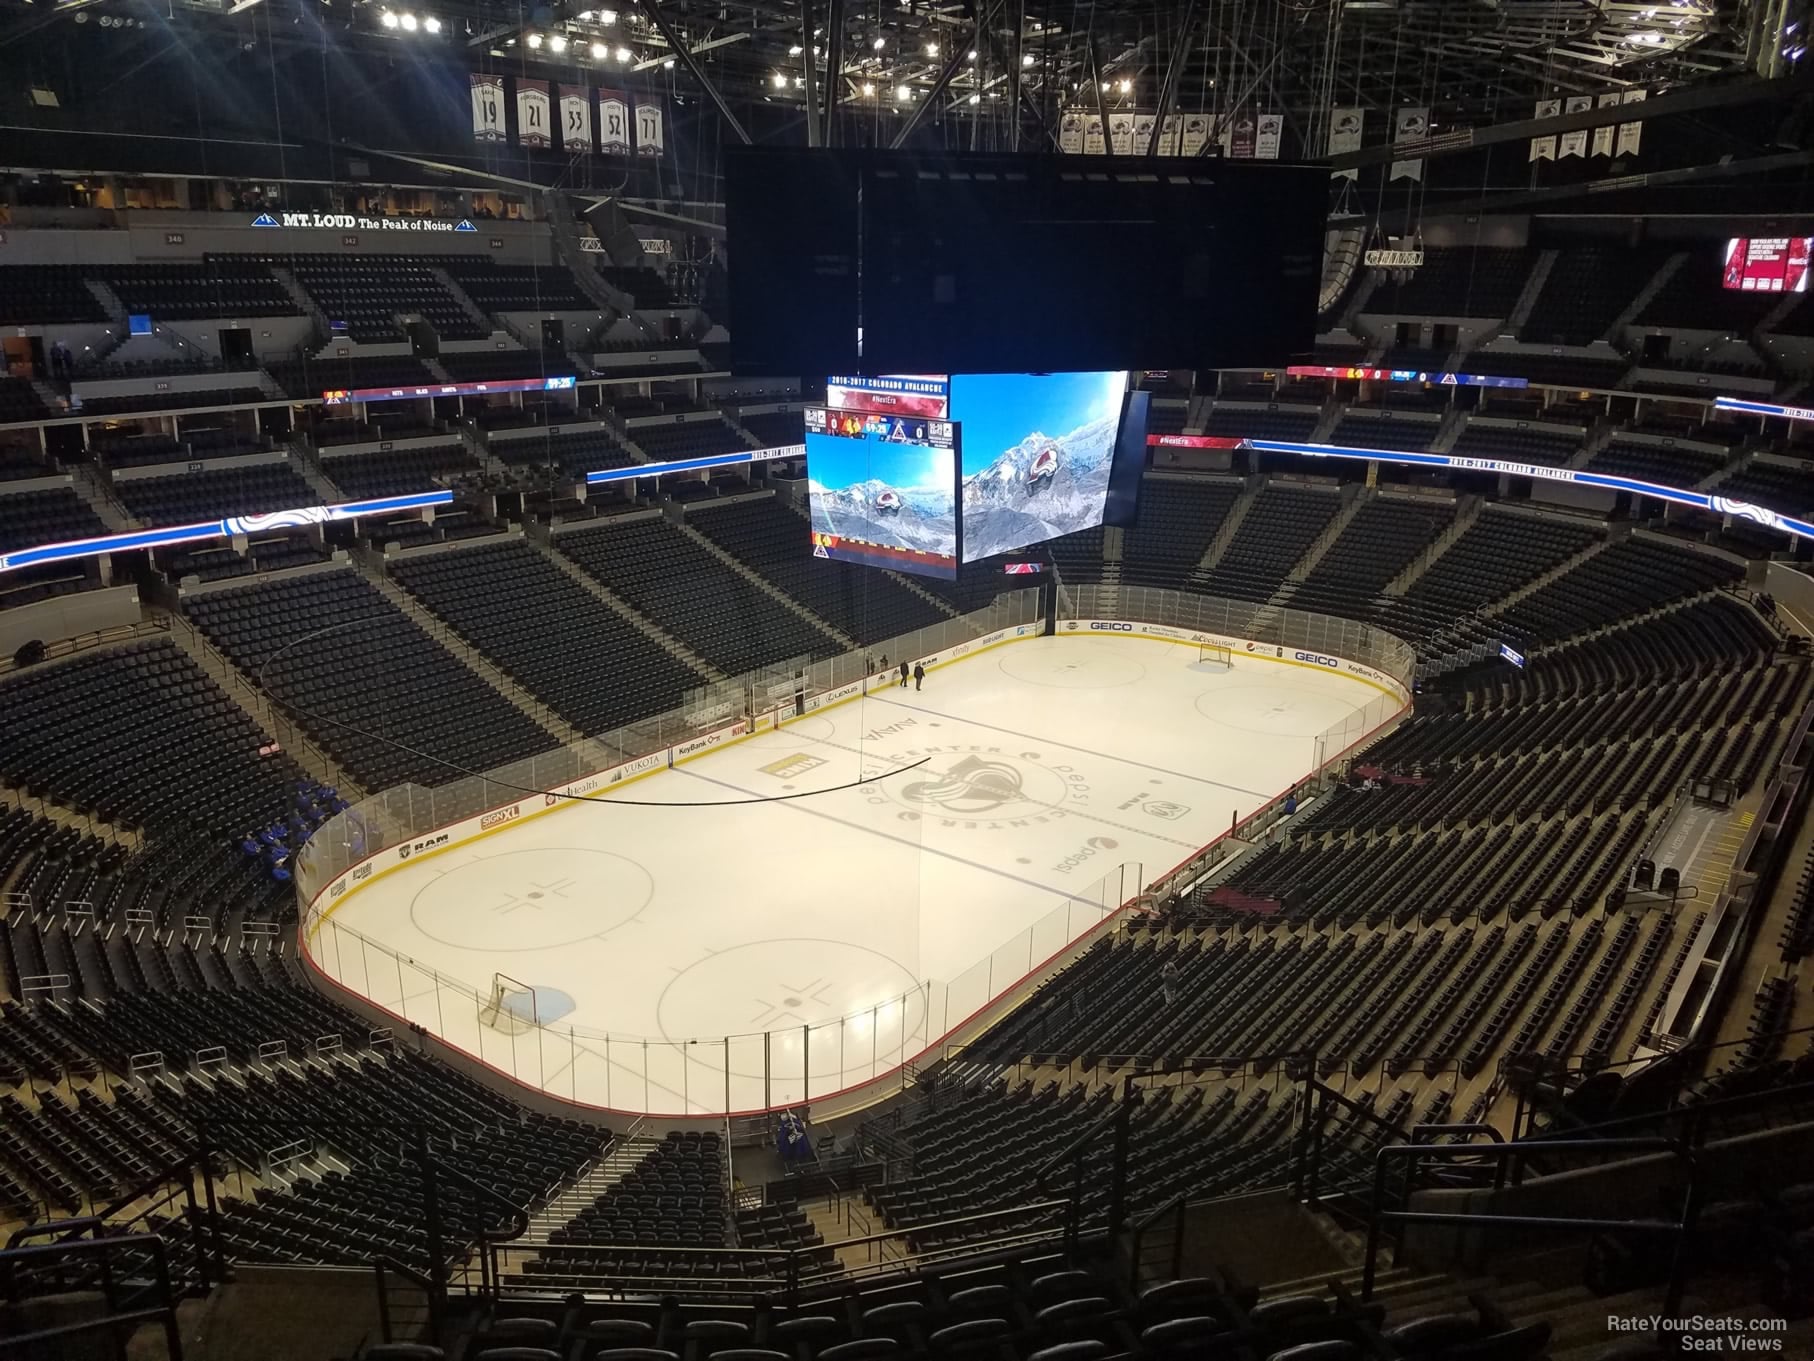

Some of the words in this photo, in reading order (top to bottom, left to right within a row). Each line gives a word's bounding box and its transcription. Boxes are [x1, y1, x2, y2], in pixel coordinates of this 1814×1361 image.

[483, 101, 497, 123] 19
[528, 106, 541, 127] 21
[568, 111, 583, 131] 33
[608, 114, 621, 136] 52
[642, 118, 656, 139] 77
[282, 213, 312, 227] MT.
[312, 214, 356, 228] LOUD
[358, 217, 380, 229] The
[382, 219, 409, 230] Peak
[410, 219, 422, 230] of
[423, 220, 453, 231] Noise
[868, 379, 902, 390] COLORADO
[905, 382, 943, 393] AVALANCHE
[872, 395, 897, 405] #NextEra
[831, 418, 838, 429] 0
[916, 427, 923, 439] 0
[1090, 622, 1133, 632] GEICO
[1295, 651, 1338, 668] GEICO
[835, 686, 858, 698] LEXUS
[861, 717, 918, 741] AVAYA
[679, 740, 707, 755] KeyBank
[624, 755, 660, 774] VUKOTA
[414, 834, 448, 851] RAM
[1051, 847, 1097, 874] pepsi
